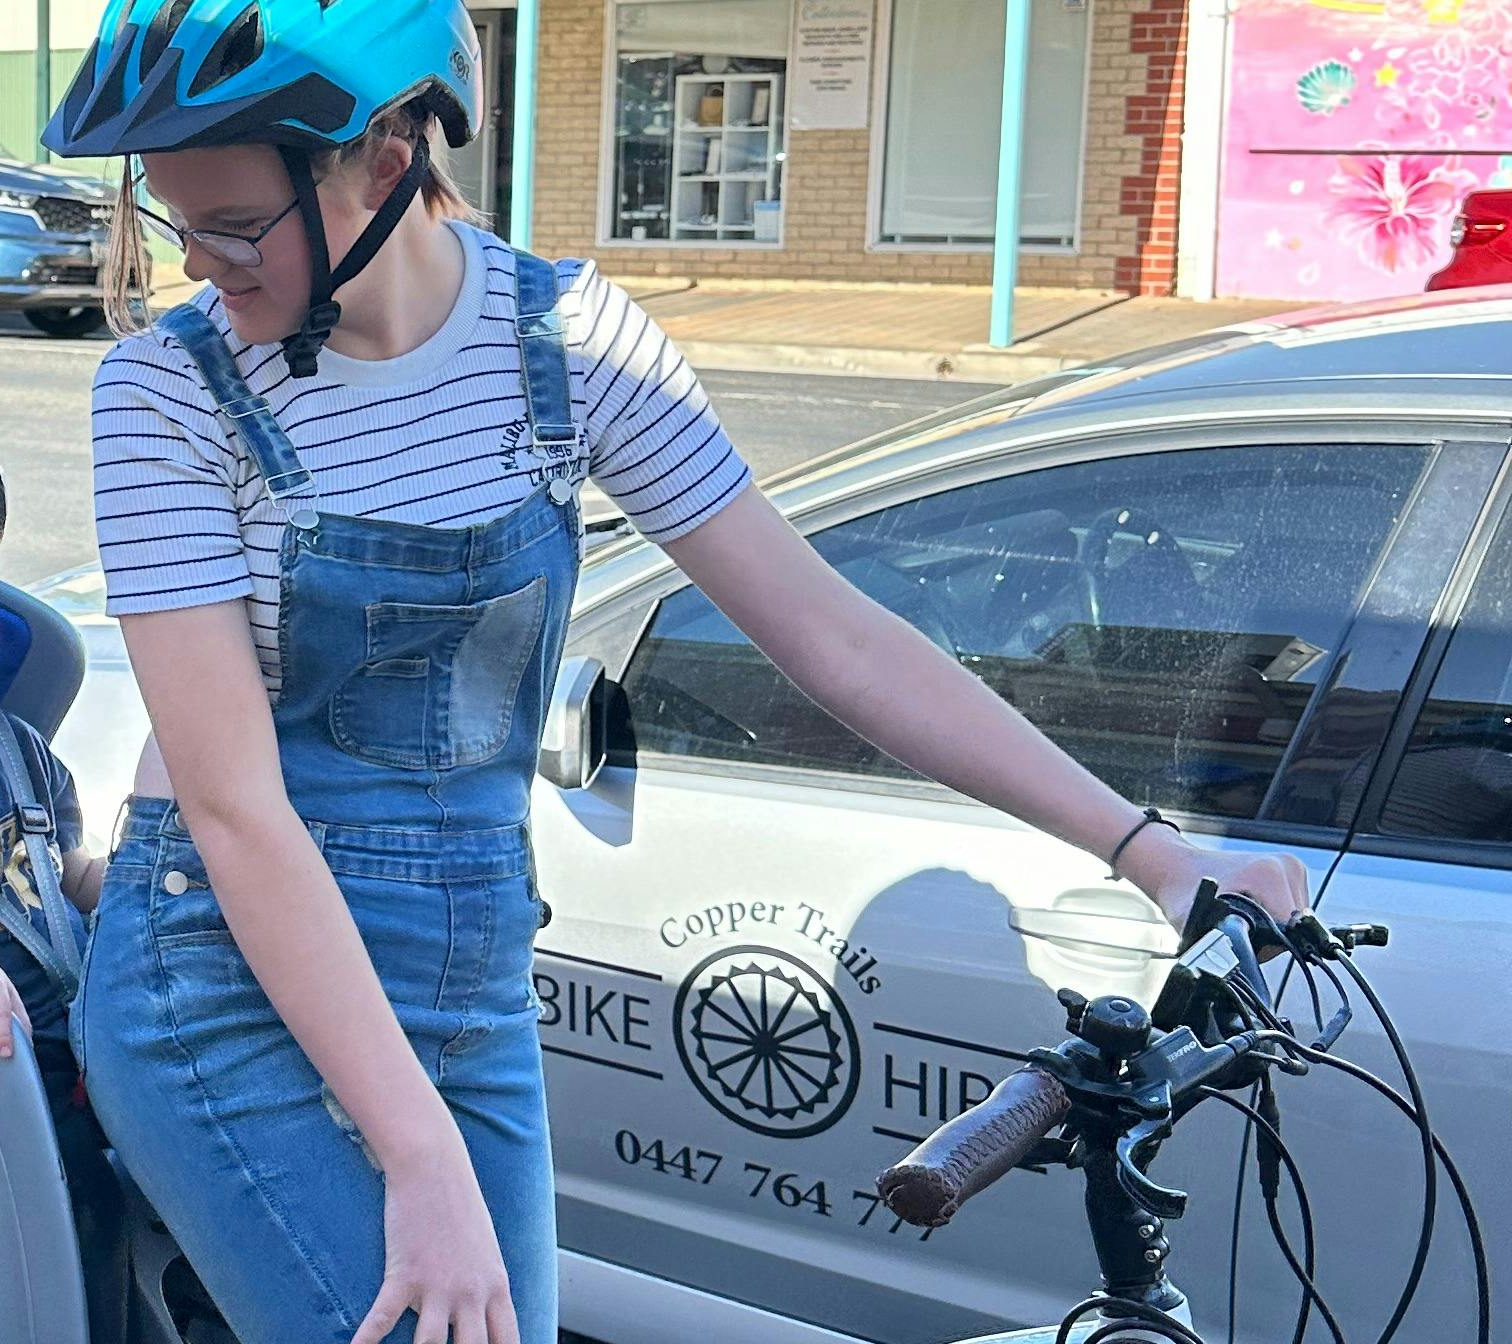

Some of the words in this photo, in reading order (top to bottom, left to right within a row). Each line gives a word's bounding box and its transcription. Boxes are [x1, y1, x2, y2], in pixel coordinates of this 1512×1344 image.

[499, 419, 526, 471] MALIBU
[659, 900, 785, 948] Copper
[793, 901, 883, 996] Trails
[535, 972, 652, 1051] BIKE
[613, 1128, 723, 1185] 0447
[743, 1162, 833, 1217] 764
